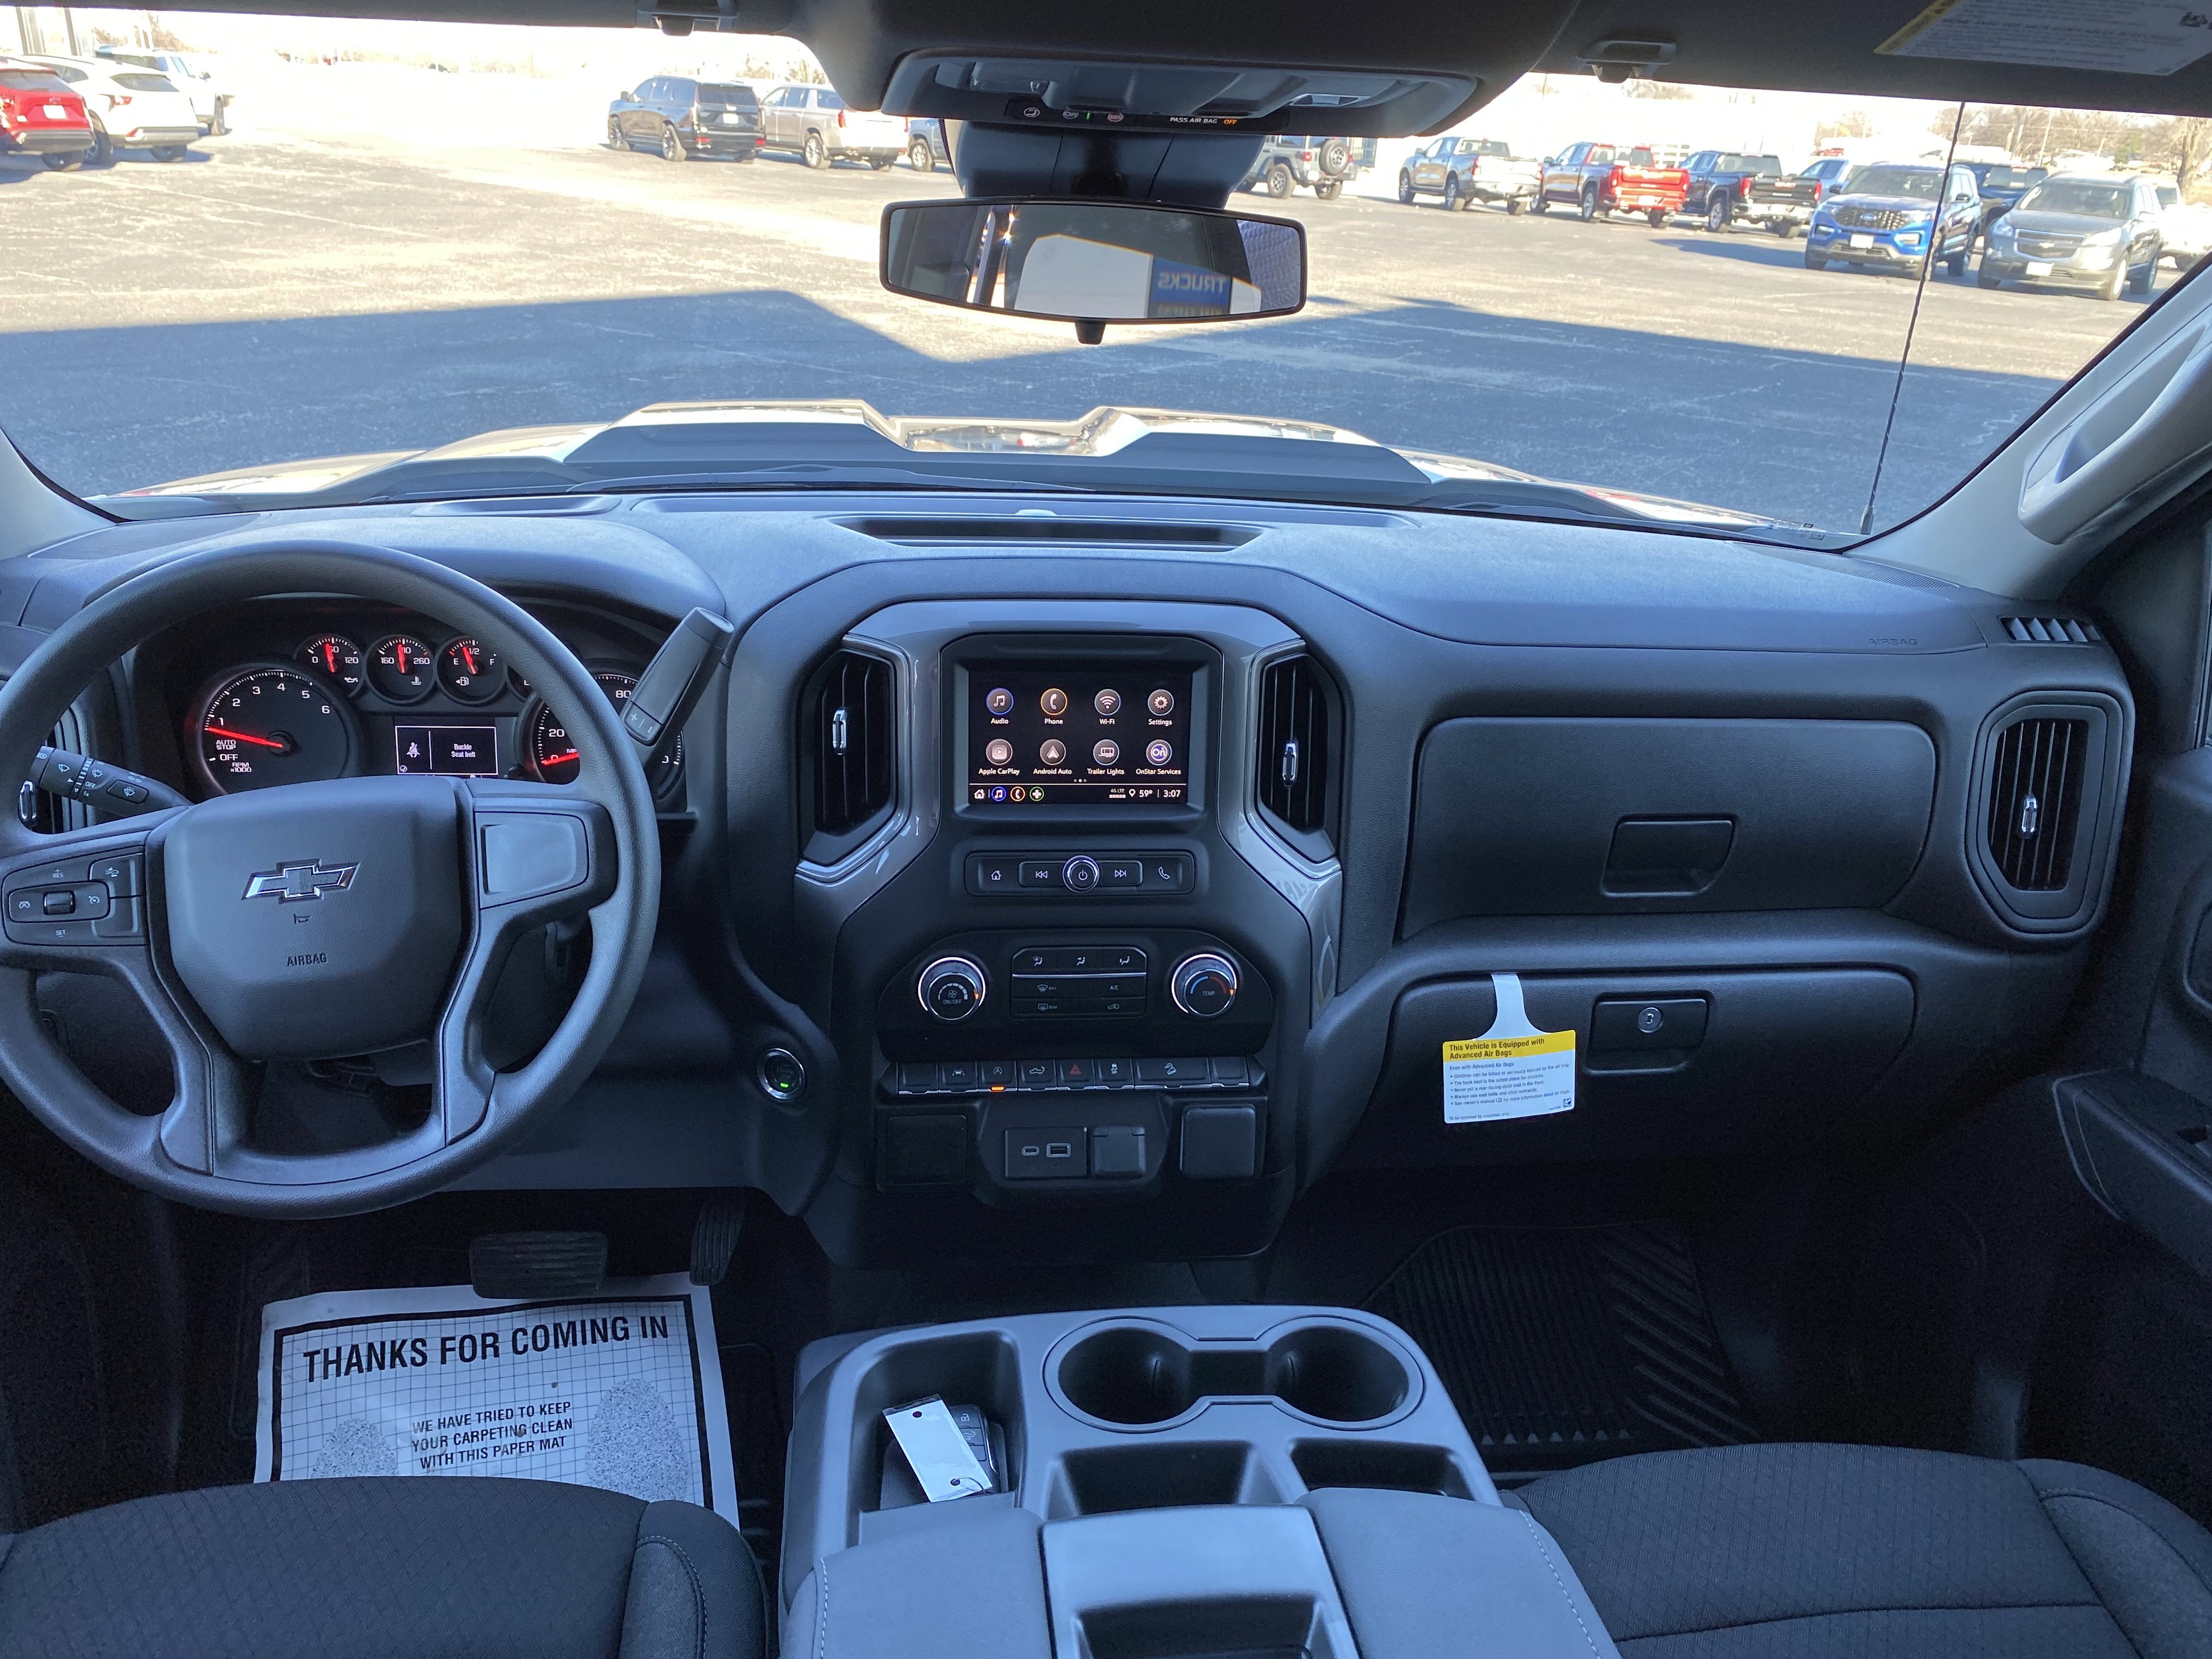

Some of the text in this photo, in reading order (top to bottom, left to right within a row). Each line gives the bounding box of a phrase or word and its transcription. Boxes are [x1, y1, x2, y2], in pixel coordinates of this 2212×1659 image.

[252, 686, 261, 695] 3
[276, 682, 285, 691] 4
[301, 690, 311, 699] 5
[615, 690, 631, 698] 80
[232, 698, 241, 707] 2
[321, 705, 330, 714] 6
[219, 717, 224, 726] 1
[549, 729, 565, 737] 20
[1163, 789, 1181, 798] 3:07
[287, 952, 327, 967] AIRBAG
[1499, 1040, 1530, 1049] Equipped
[1449, 1051, 1482, 1059] Advanced
[303, 1316, 668, 1383] THANKS FOR COMING IN
[413, 1401, 571, 1434] WE HAVE TRIED TO KEEP
[411, 1418, 573, 1452] YOUR CARPETING CLEAN
[420, 1436, 566, 1469] WITH THIS PAPER MAT
